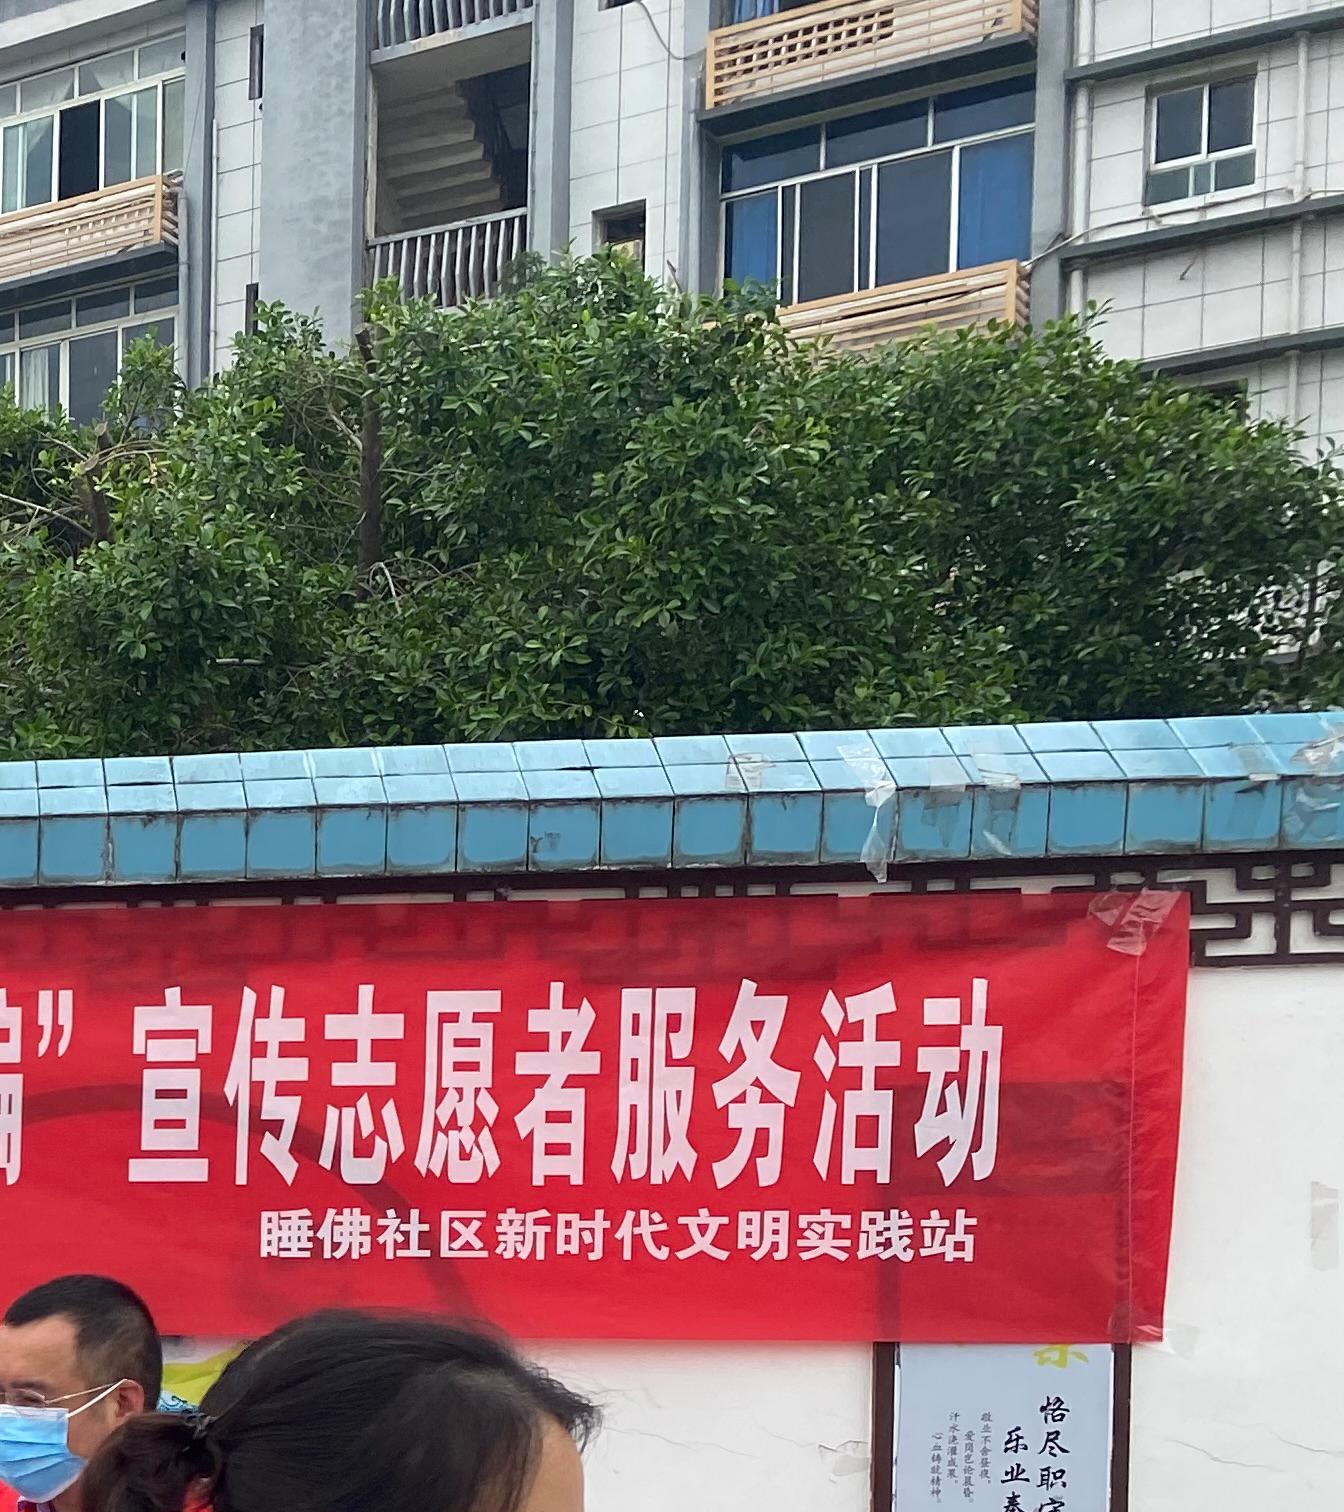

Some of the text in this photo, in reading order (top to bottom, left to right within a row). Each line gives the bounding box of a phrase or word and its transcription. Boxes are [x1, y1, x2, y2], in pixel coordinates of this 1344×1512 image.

[258, 1205, 978, 1264] 睡佛社区新时代文明实践站
